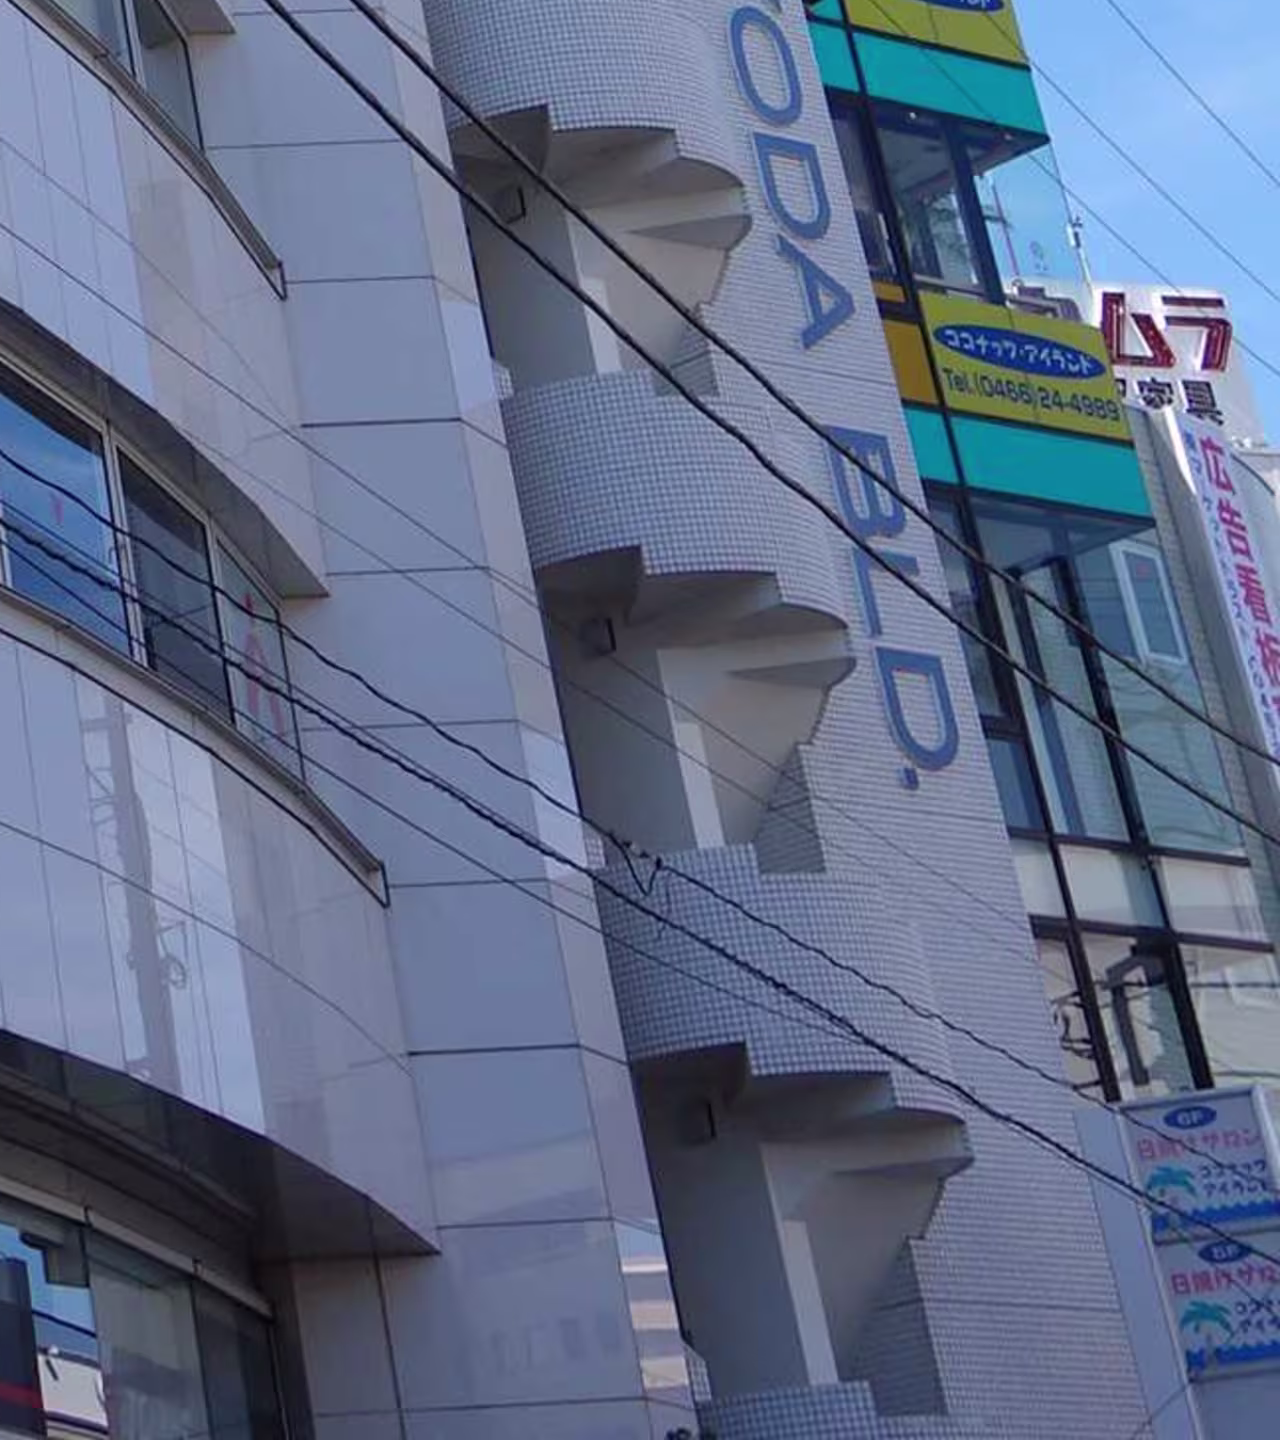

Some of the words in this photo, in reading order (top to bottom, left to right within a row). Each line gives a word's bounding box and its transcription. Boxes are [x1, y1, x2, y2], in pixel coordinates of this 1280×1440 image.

[824, 422, 962, 792] BLD.
[1200, 436, 1280, 728] 広告看板
[1171, 1260, 1280, 1296] 日焼けサロ
